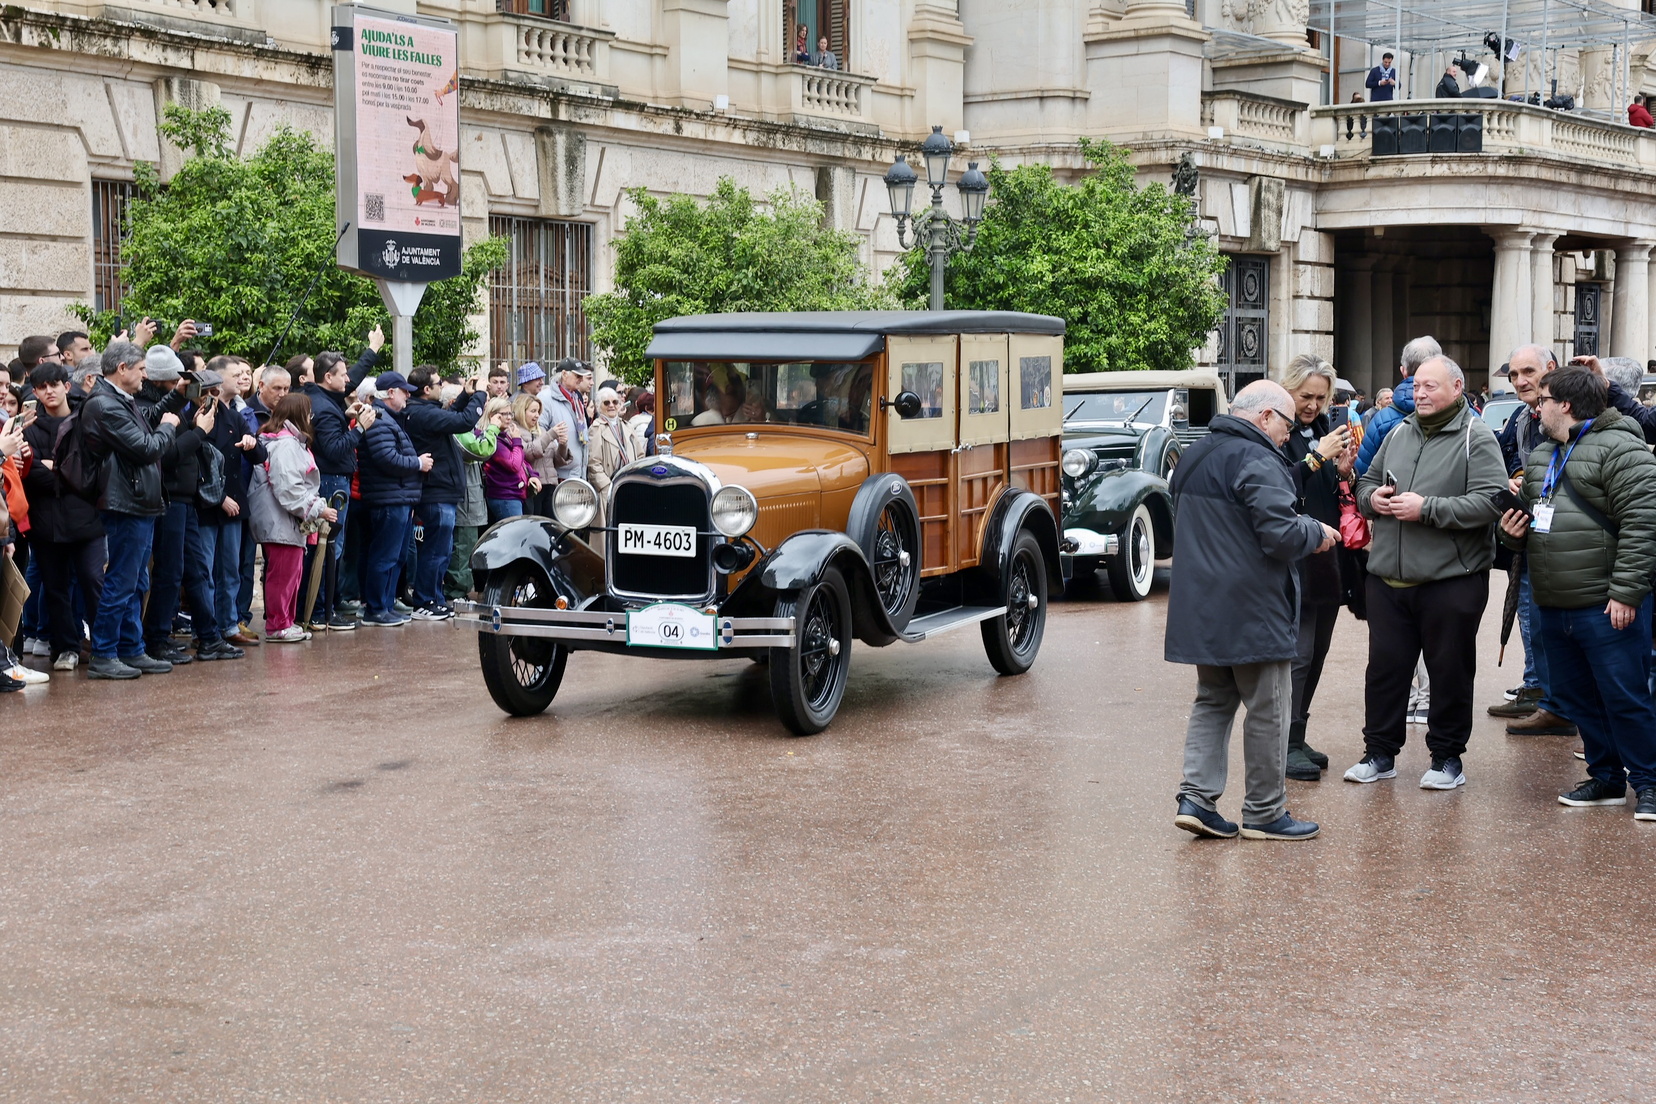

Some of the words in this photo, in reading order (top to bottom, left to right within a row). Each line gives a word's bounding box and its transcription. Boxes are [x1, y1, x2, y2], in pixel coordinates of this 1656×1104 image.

[361, 28, 405, 46] AJUDA'LS
[407, 36, 414, 47] A
[361, 43, 391, 58] VIURE
[393, 48, 409, 61] LES
[410, 51, 442, 67] FALLES
[402, 246, 440, 256] AJUNTAMENT
[411, 256, 440, 266] VALÈNCIA
[668, 420, 674, 429] H
[624, 530, 691, 551] PM-4603
[664, 625, 679, 638] 04
